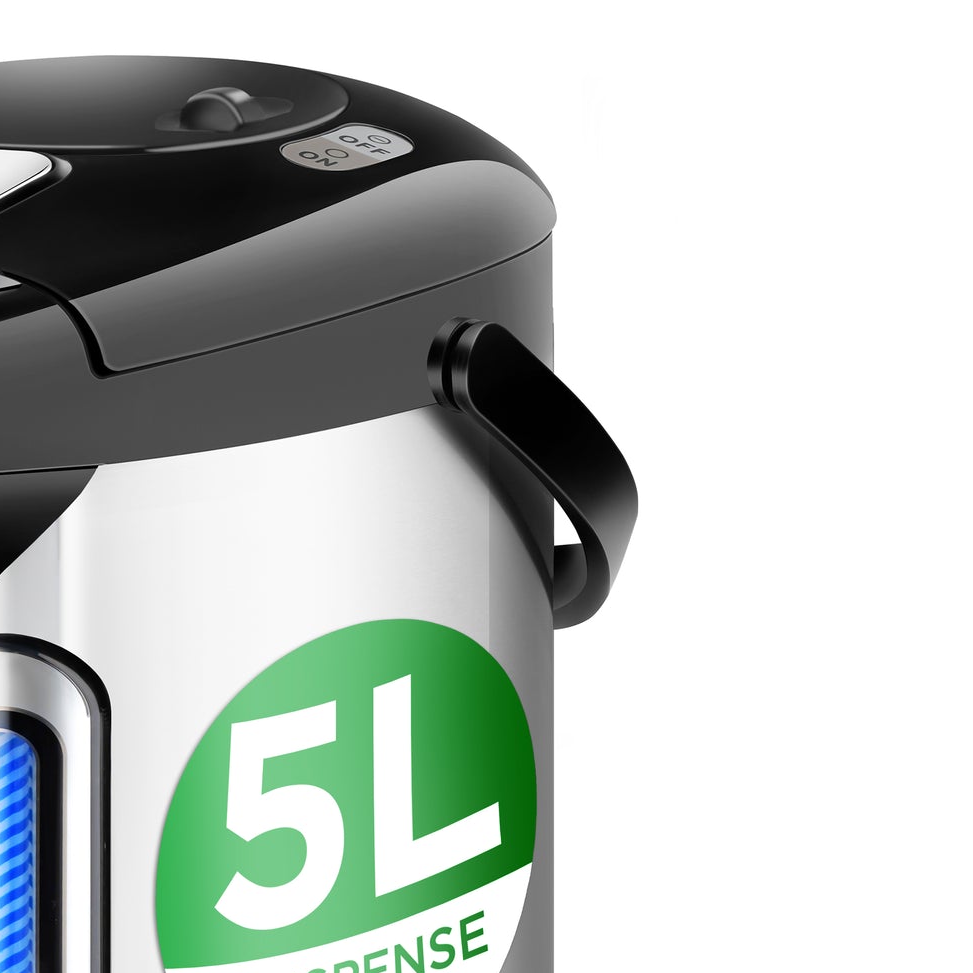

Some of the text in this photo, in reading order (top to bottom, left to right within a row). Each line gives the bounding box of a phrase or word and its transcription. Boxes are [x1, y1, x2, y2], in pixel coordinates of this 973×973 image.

[338, 135, 391, 155] OFF
[298, 151, 338, 167] ON
[214, 674, 502, 930] 5L
